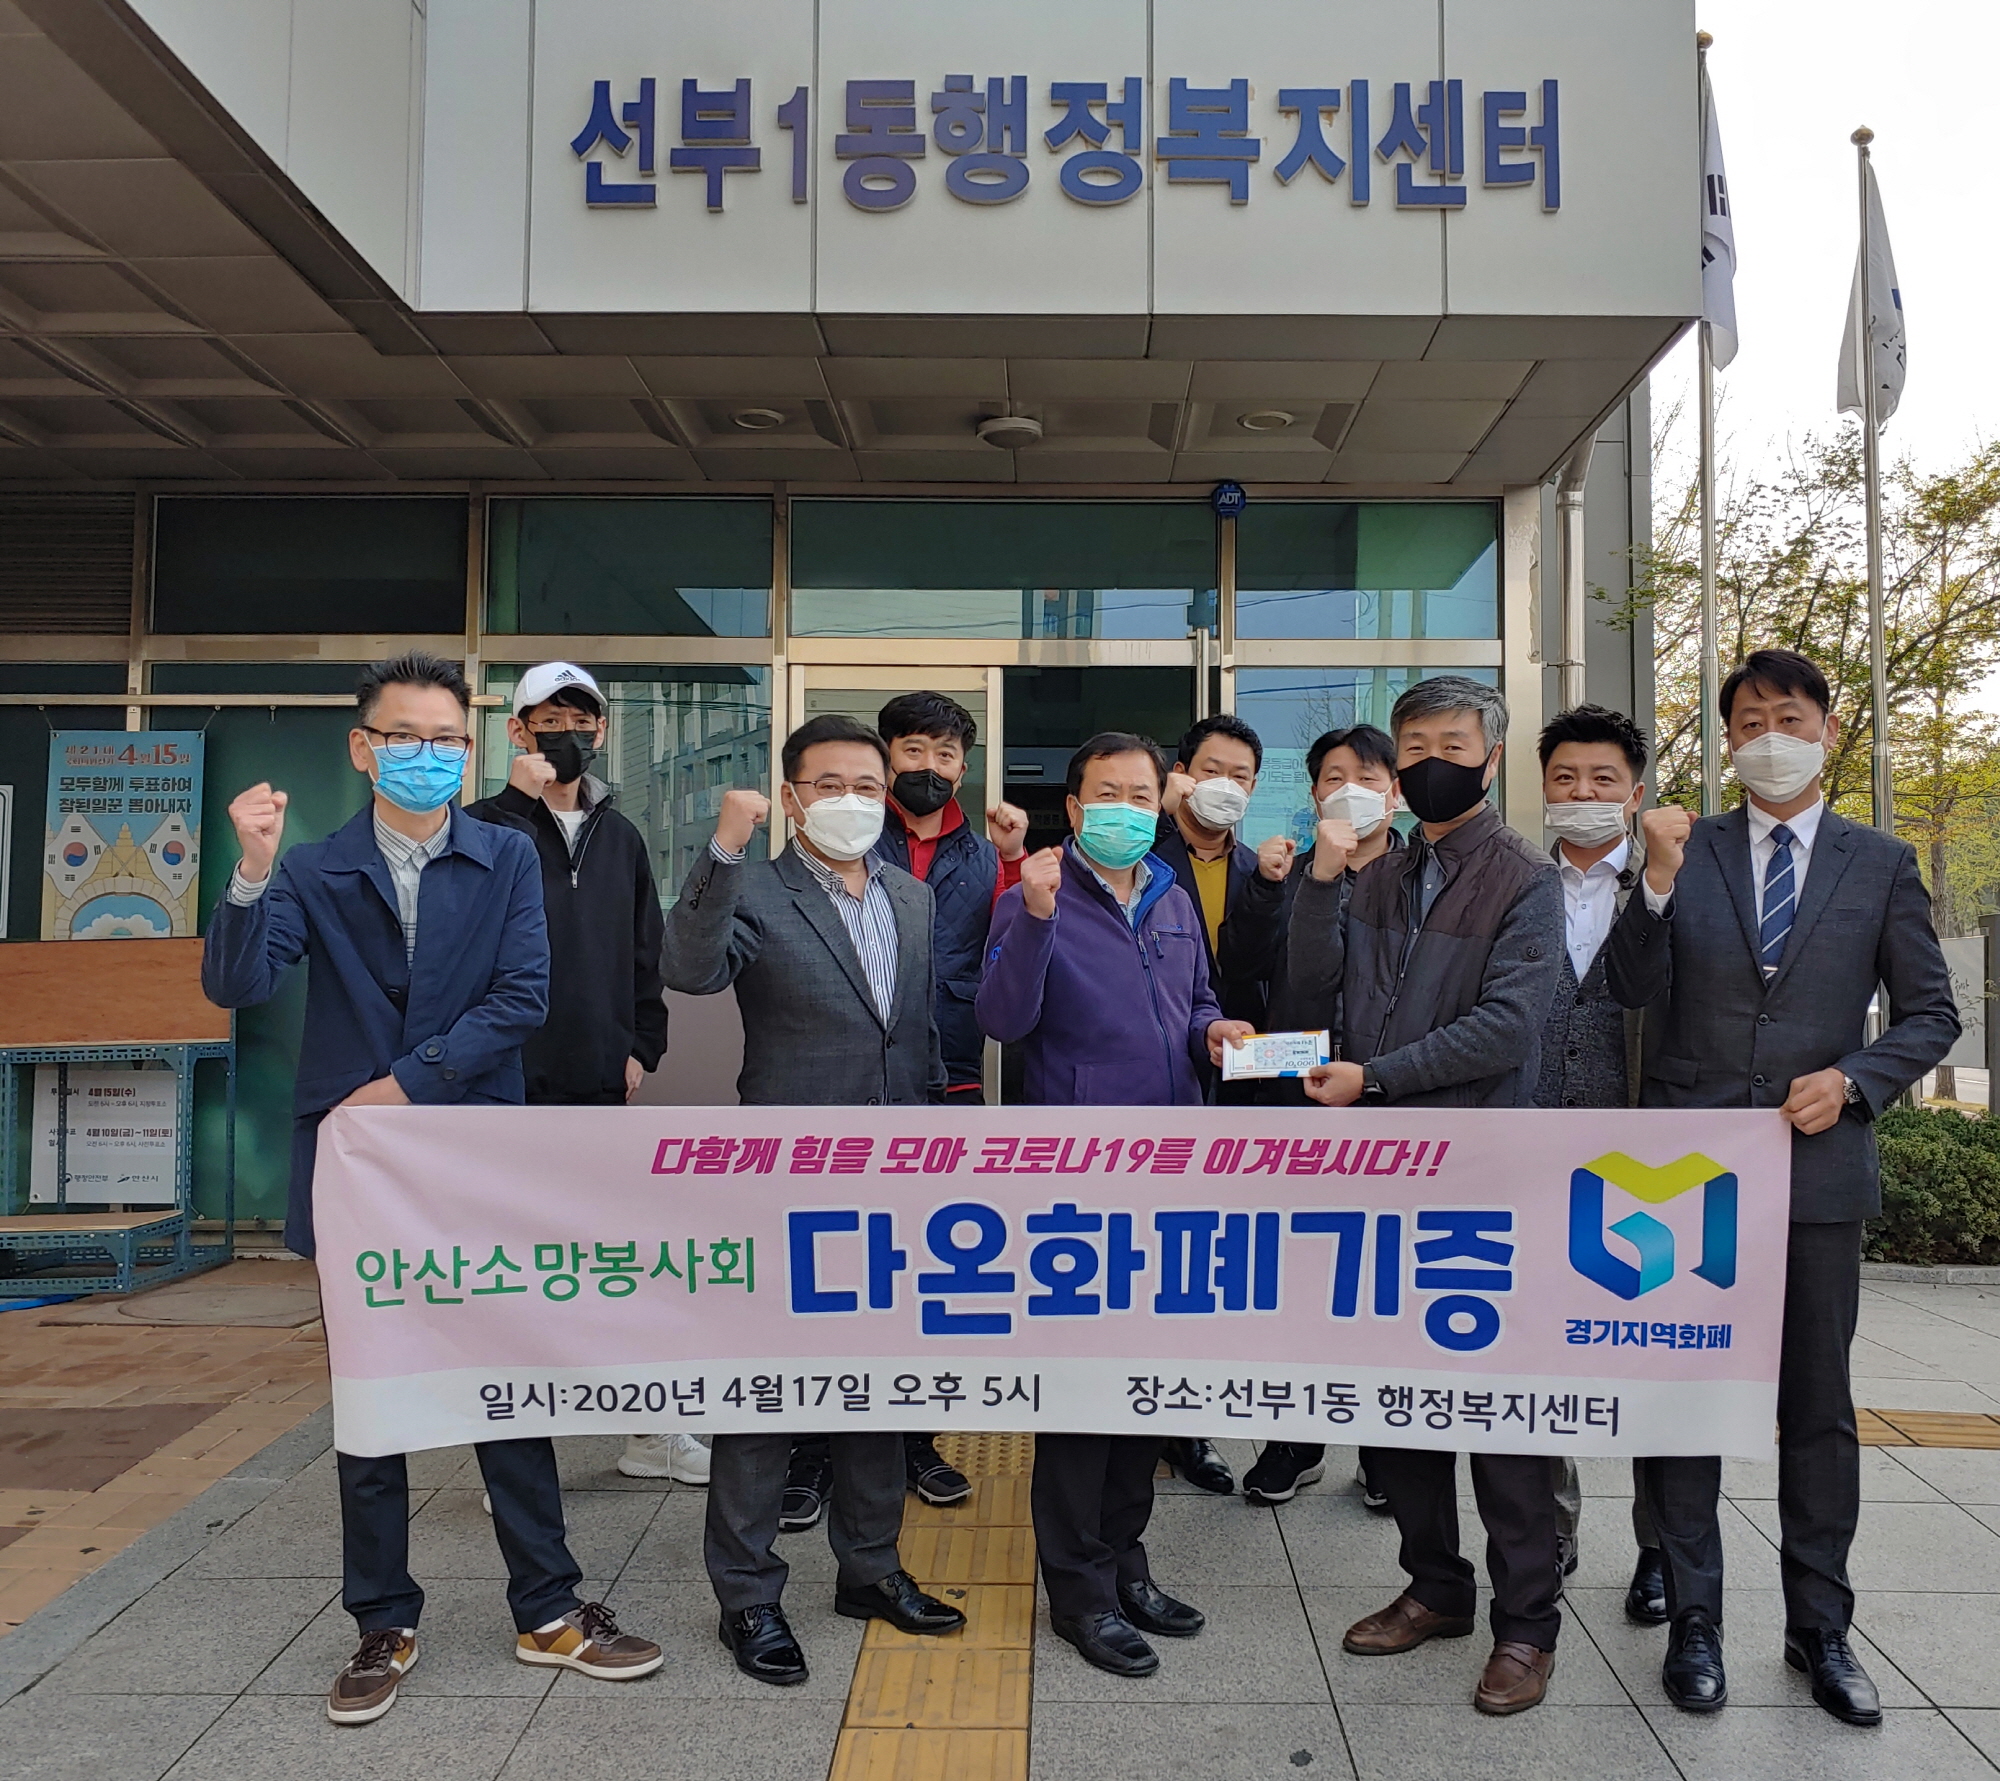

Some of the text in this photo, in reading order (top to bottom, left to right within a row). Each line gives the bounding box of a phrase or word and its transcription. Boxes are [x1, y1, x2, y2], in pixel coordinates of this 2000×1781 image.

[570, 74, 1562, 213] 선부1동행정복지센터
[1217, 492, 1240, 505] ADT
[59, 776, 192, 793] 모두함께 투표하여
[59, 797, 192, 814] 참된일꾼 뽑아내자
[650, 1135, 1451, 1177] 다함께 힘을 모아 코로나19를 이겨냅시다!!
[355, 1203, 1516, 1352] 안산소망봉사회 다온화폐기증
[1565, 1319, 1733, 1350] 경기지역화폐
[480, 1376, 706, 1421] 일시:2020년
[888, 1372, 967, 1412] 오후
[982, 1373, 1041, 1413] 5시
[1127, 1375, 1620, 1438] 장소:선부1동 행정복지센터
